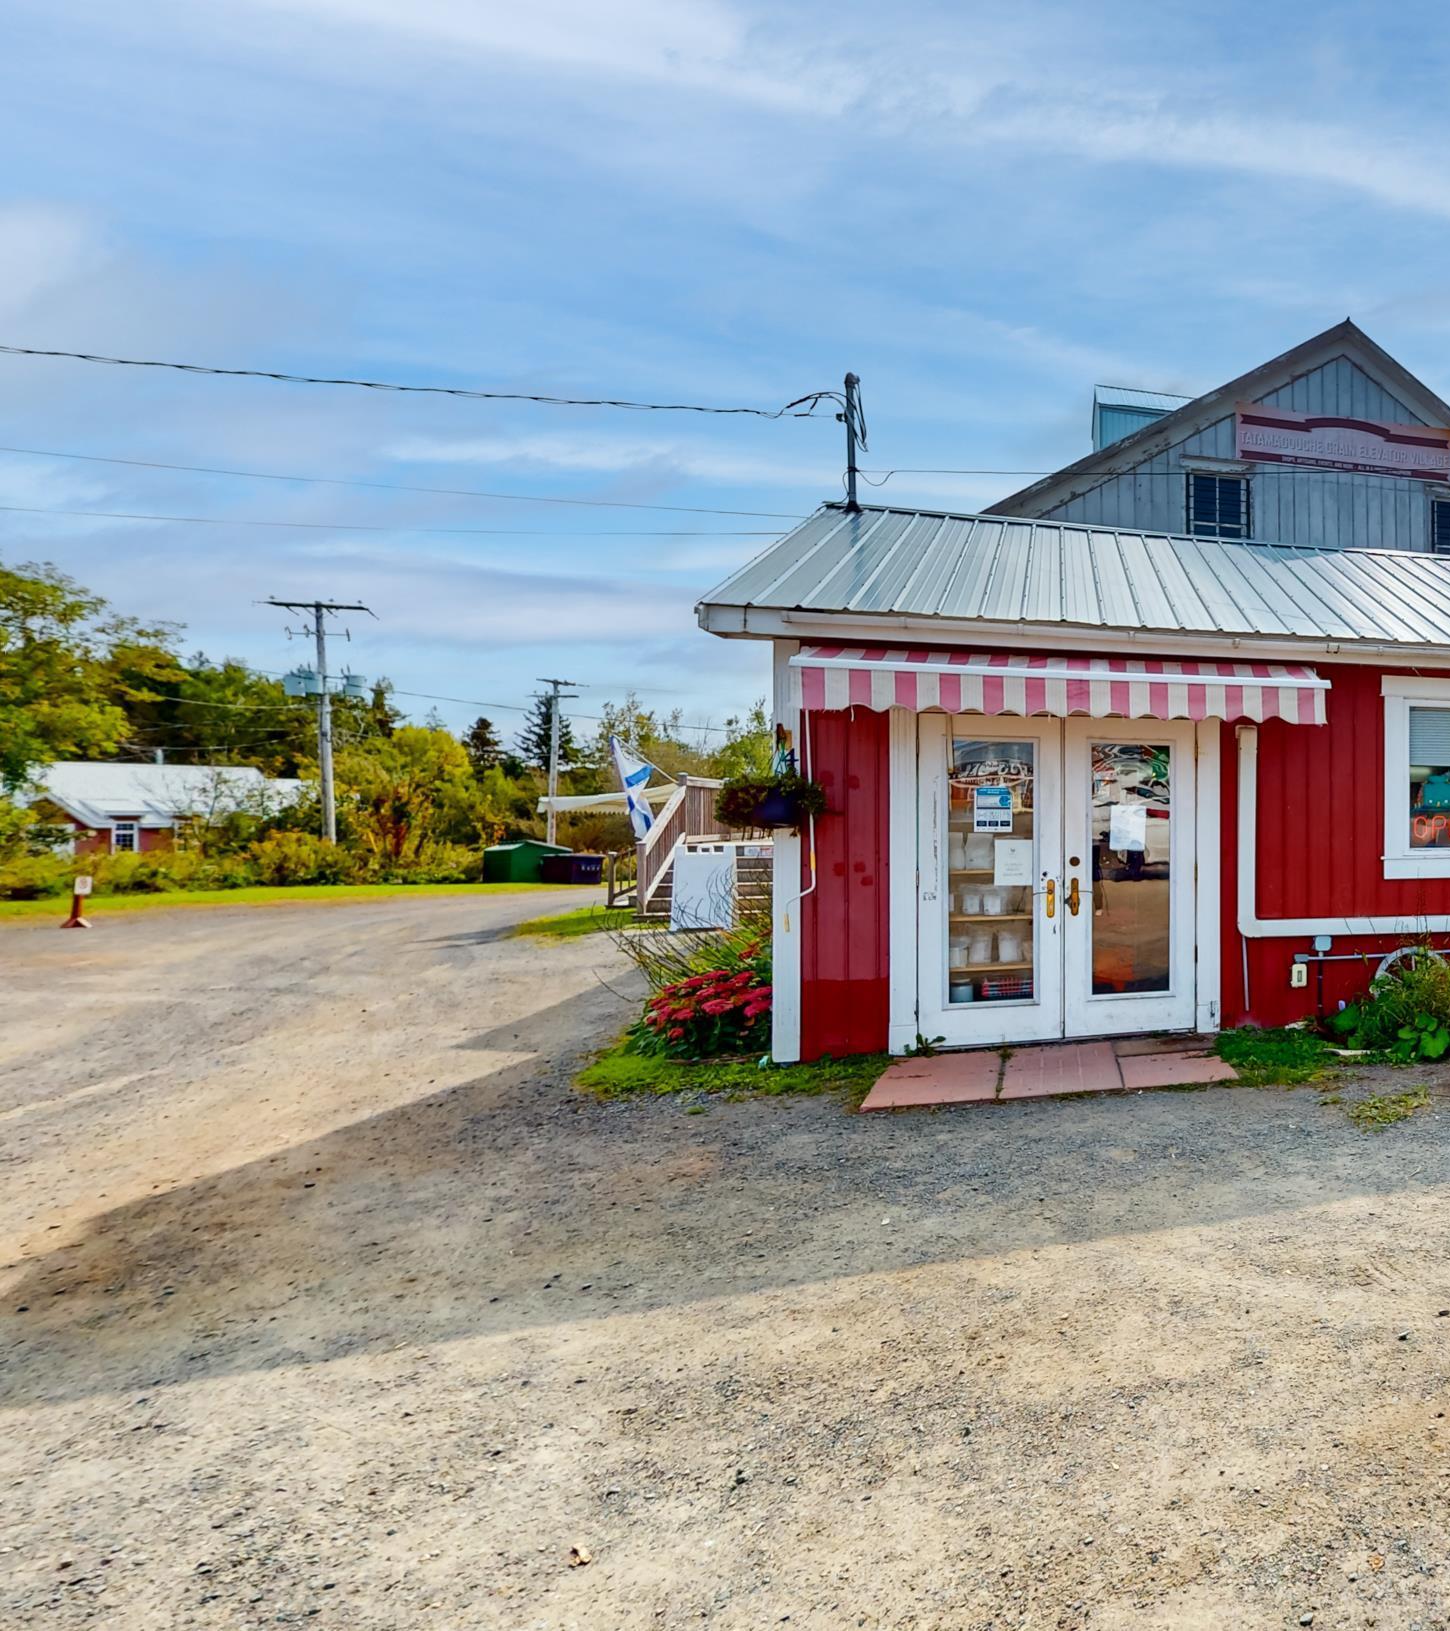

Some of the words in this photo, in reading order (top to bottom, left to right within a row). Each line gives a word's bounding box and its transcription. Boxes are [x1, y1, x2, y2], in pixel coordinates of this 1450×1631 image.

[1326, 441, 1357, 458] GRAIN
[1359, 445, 1407, 465] ELEVATOR
[1409, 451, 1450, 468] VILLAGE
